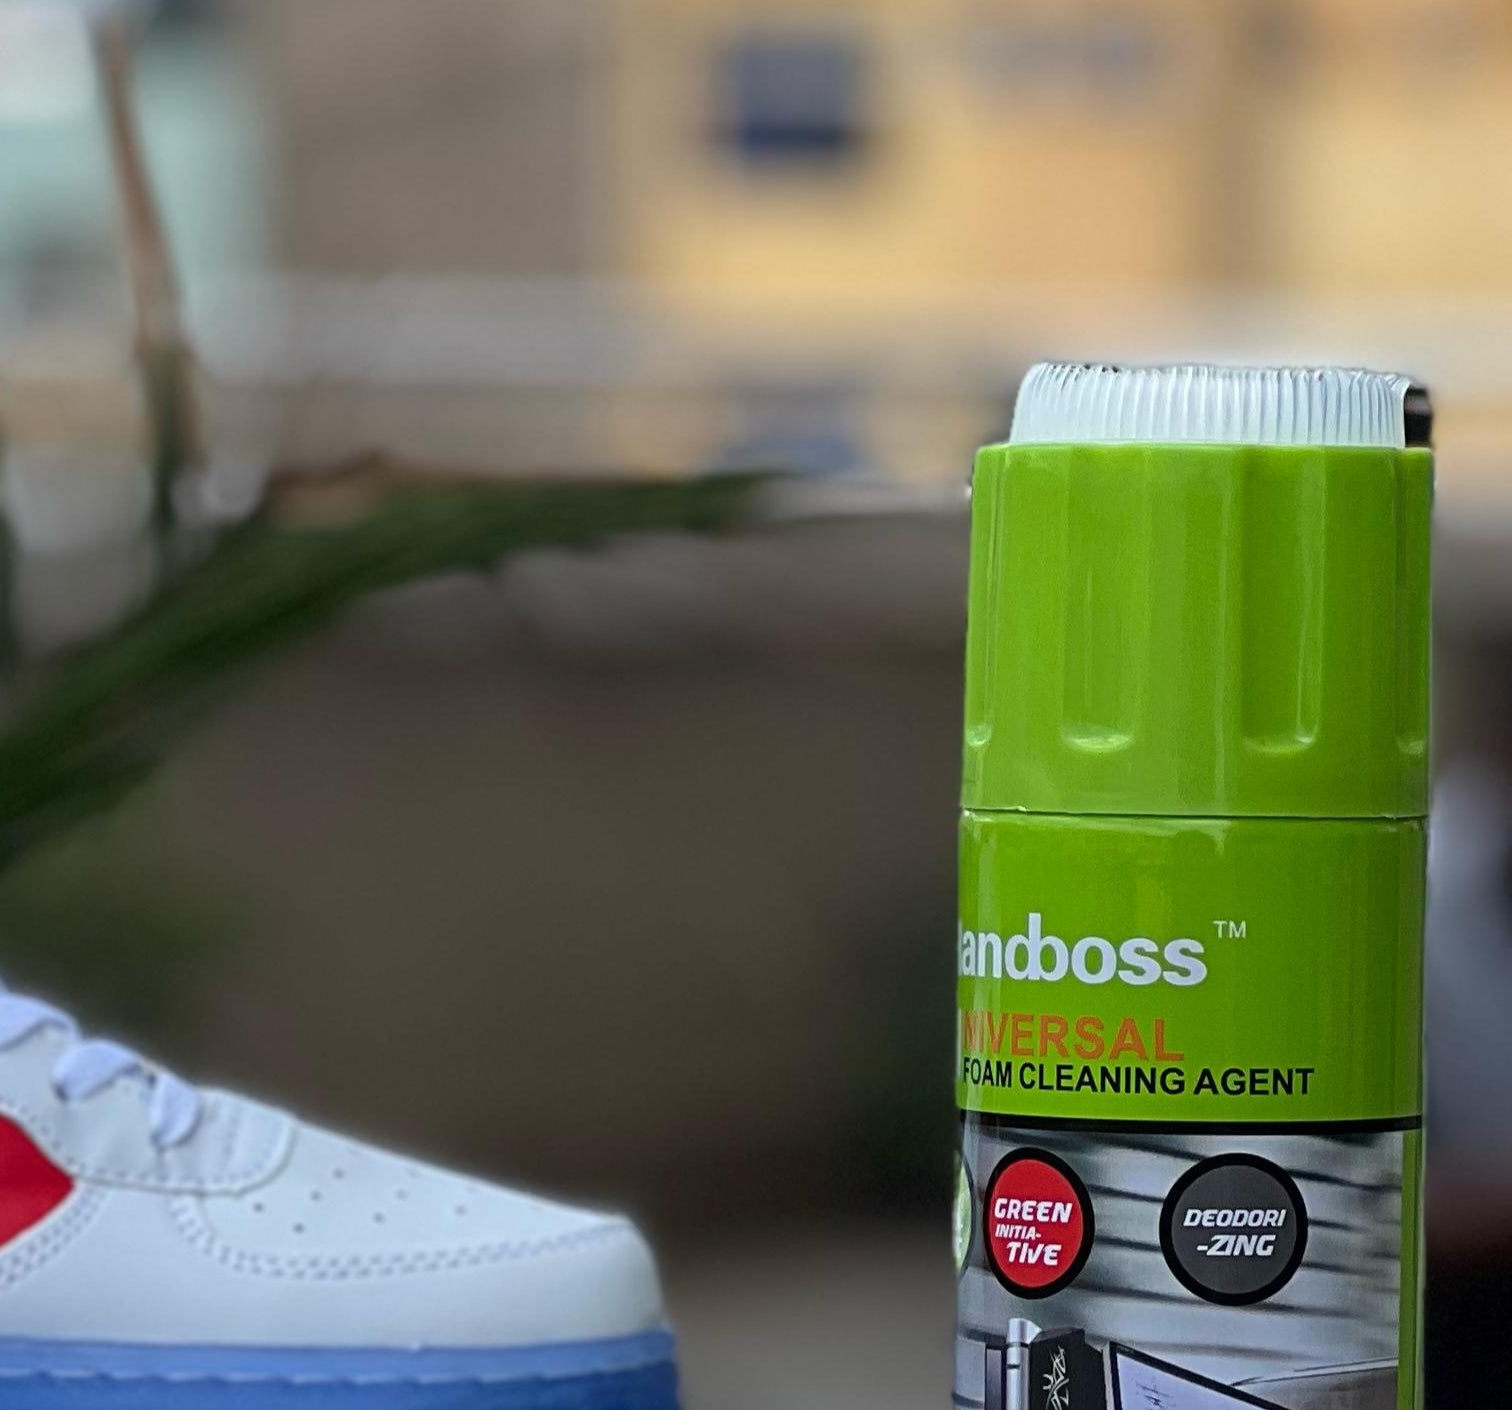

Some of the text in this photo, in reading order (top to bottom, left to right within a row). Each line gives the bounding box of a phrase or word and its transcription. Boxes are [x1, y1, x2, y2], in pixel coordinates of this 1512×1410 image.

[959, 912, 1208, 986] andboss
[963, 1056, 1316, 1096] FOAM CLEANING AGENT
[994, 1197, 1073, 1224] GREEN
[1183, 1208, 1287, 1227] DEODORI
[994, 1223, 1042, 1240] INITIA-
[1006, 1241, 1063, 1266] TIVE
[1196, 1234, 1277, 1256] -ZING
